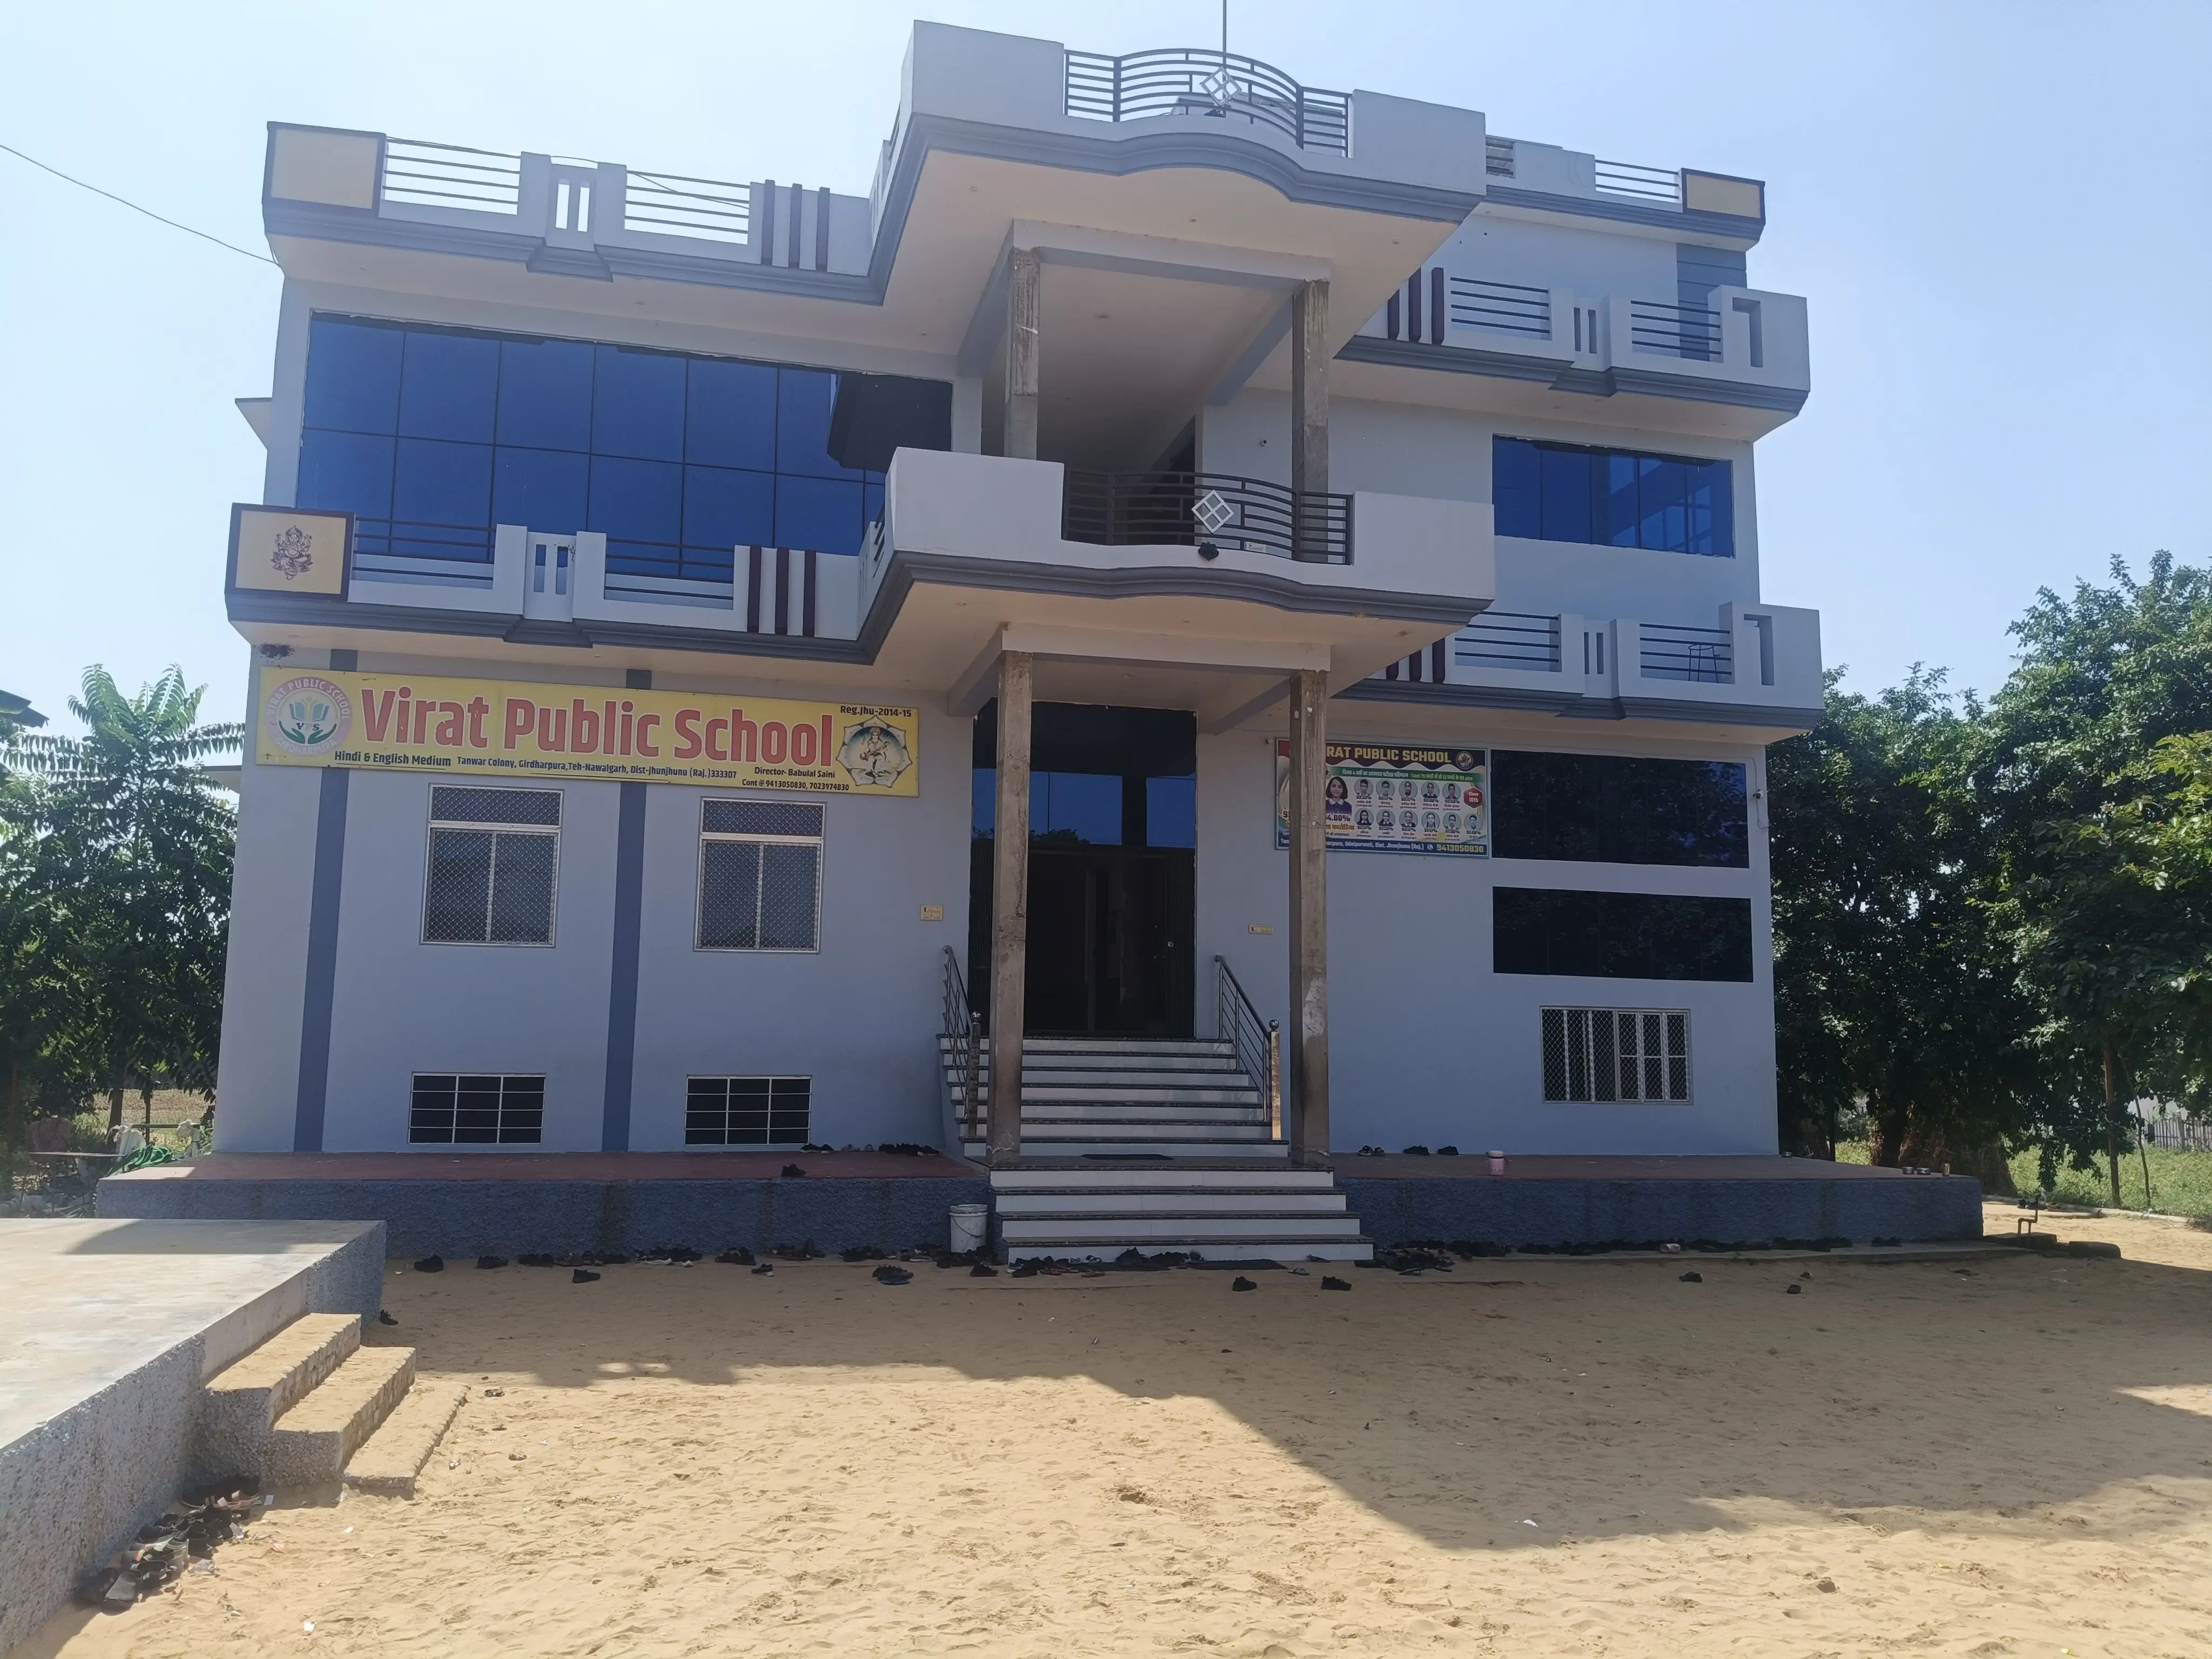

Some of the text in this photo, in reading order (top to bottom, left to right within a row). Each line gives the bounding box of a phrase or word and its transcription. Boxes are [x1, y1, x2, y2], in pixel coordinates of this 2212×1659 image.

[266, 679, 350, 719] VIRAT PUBLIC SCHOOL
[361, 686, 833, 766] Virat Public School
[334, 751, 451, 766] Hindi & English Medium
[1326, 746, 1451, 763] RAT PUBLIC SCHOOL
[457, 757, 486, 766] Tanwar
[488, 758, 516, 768] Colony,
[788, 768, 816, 777] Babulal
[766, 780, 808, 790] 9413050830,
[810, 783, 849, 791] 7023974830
[1437, 844, 1484, 853] 9413050830
